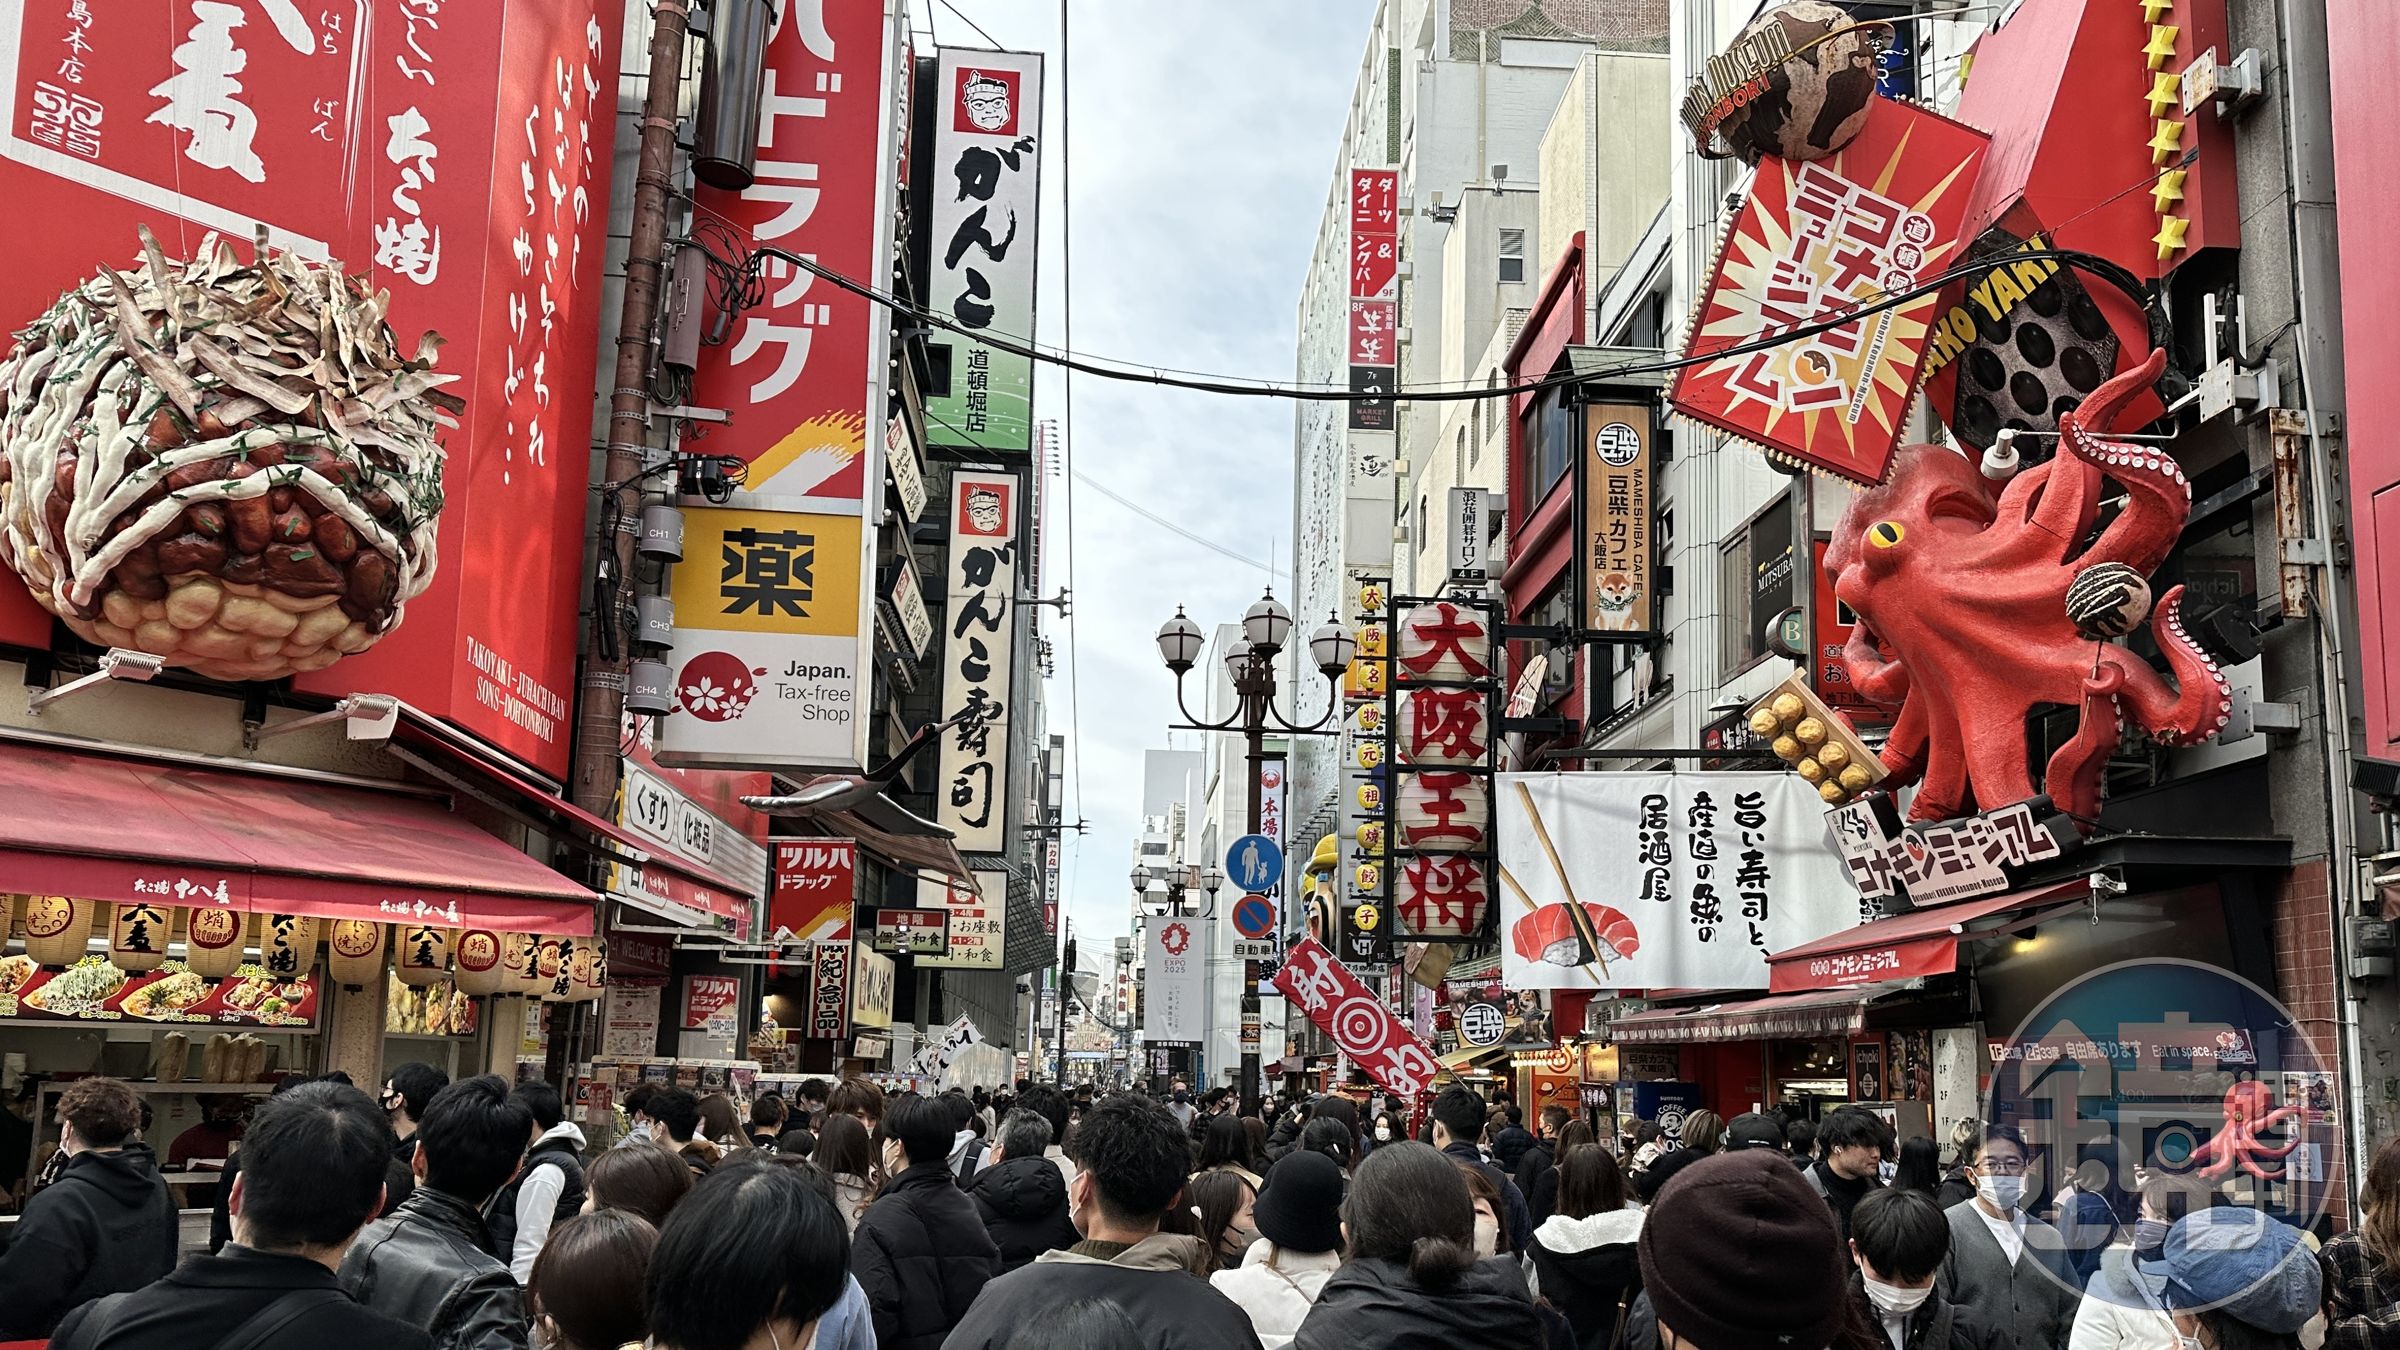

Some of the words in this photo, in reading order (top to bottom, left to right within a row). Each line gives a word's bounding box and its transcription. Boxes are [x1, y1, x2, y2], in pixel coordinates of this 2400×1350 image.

[1377, 178, 1393, 223] ダーツ
[944, 135, 1036, 329] がんこ
[1356, 178, 1373, 297] ダイニングバー
[1377, 243, 1392, 258] &
[1886, 217, 1930, 297] 道頓堀
[1969, 232, 2060, 322] YAKI
[1382, 288, 1395, 297] 9F
[1351, 302, 1365, 313] 8F
[1367, 371, 1378, 380] 7F
[965, 349, 990, 433] 道頓堀店
[1633, 468, 1644, 549] MAMESHIBA
[649, 529, 670, 540] CH1
[1461, 491, 1478, 568] 浪花囲碁サロン
[1594, 532, 1608, 570] 大阪店
[720, 528, 815, 618] 薬
[1633, 554, 1644, 591] CAFE
[649, 619, 670, 632] CH3
[784, 660, 851, 682] Japan.
[635, 685, 657, 696] CH4
[774, 683, 851, 702] Tax-free
[801, 703, 850, 724] Shop
[637, 784, 669, 831] くすり
[684, 811, 710, 856] 化粧品
[781, 847, 851, 870] ツルハ
[1638, 794, 1672, 902] 居酒屋
[1688, 791, 1724, 943] 産直の魚の
[779, 874, 837, 890] ドラッグ
[896, 913, 924, 926] 地階
[1234, 944, 1271, 955] 自動車
[1164, 959, 1187, 967] EXPO
[692, 980, 735, 996] ツルハ
[1938, 1064, 1948, 1074] 3F
[1939, 1090, 1949, 1101] 2F
[1657, 1103, 1688, 1116] COFFEE
[1941, 1116, 1950, 1126] 1F
